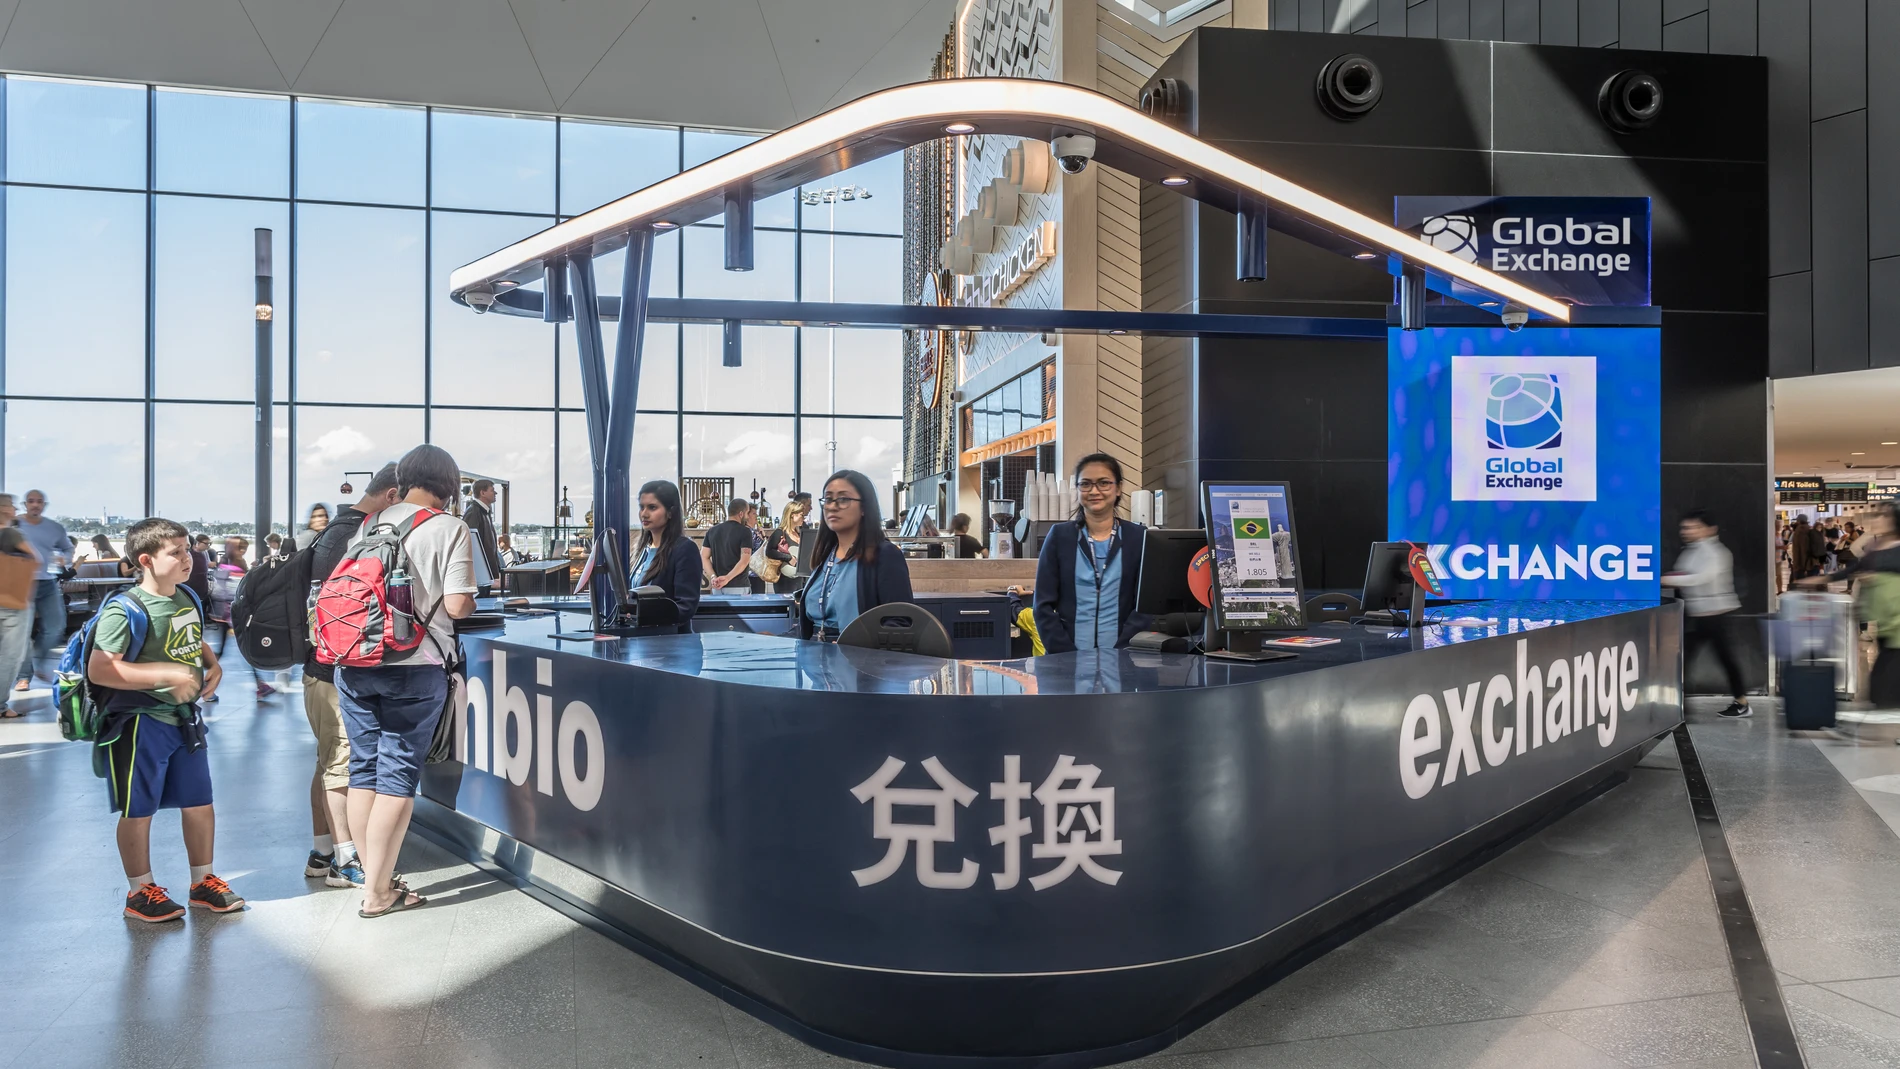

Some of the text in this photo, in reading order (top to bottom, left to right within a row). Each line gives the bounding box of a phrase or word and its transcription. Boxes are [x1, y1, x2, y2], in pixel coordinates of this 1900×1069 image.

[1492, 217, 1631, 245] Global
[991, 228, 1044, 300] CHICKEN
[1492, 248, 1631, 276] Exchange
[1485, 458, 1563, 474] Global
[1485, 474, 1563, 491] Exchange
[1247, 568, 1268, 576] 1.805
[1426, 544, 1653, 581] XCHANGE
[1399, 638, 1639, 800] exchange
[850, 754, 1124, 892] 兌換
